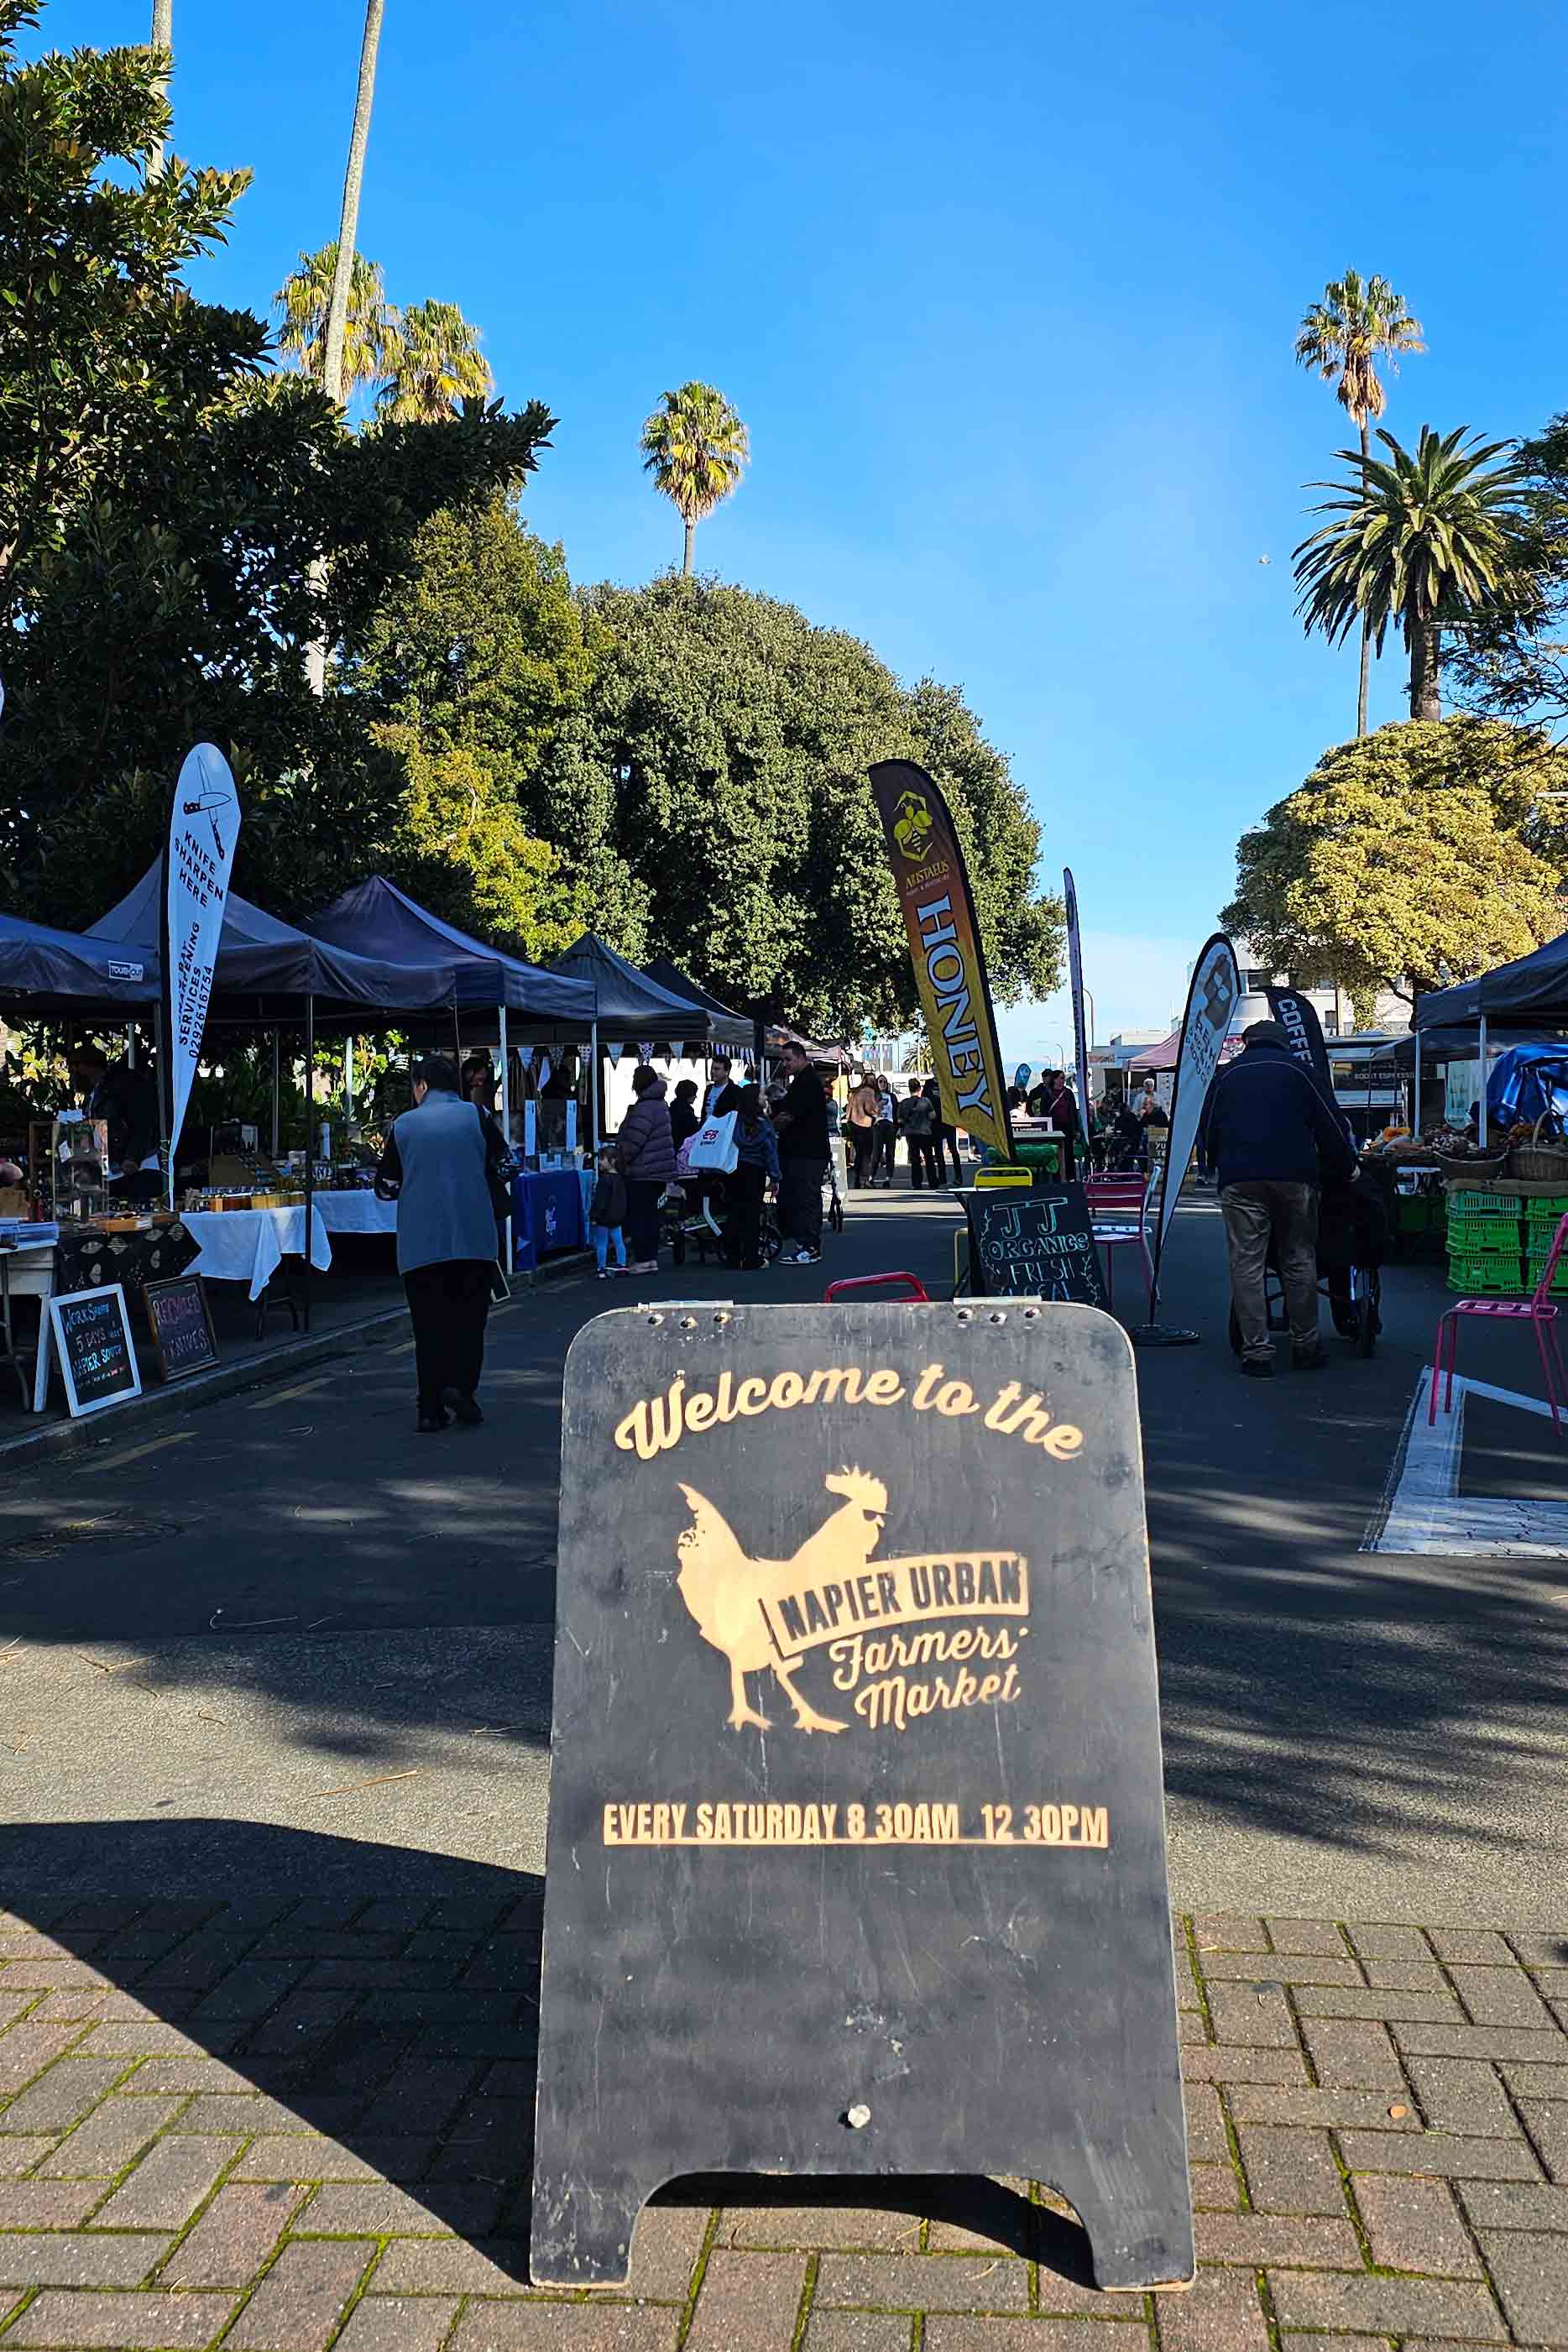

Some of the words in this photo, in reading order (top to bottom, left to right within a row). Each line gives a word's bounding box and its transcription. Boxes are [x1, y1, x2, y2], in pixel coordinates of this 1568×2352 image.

[174, 837, 223, 901] SHARPEN
[184, 829, 216, 875] KNIFE
[179, 867, 208, 907] HERE
[178, 965, 202, 1047] SERVICES
[188, 964, 213, 1059] 0292616754
[916, 892, 996, 1122] HONEY
[1277, 997, 1315, 1068] COFFE
[987, 1231, 1090, 1261] ORGANICS
[1011, 1257, 1075, 1285] FRESH
[614, 1364, 906, 1461] Welcome
[912, 1364, 980, 1417] to
[984, 1381, 1085, 1461] the
[777, 1571, 902, 1642] NAPIER
[908, 1559, 1022, 1610] URBAN
[853, 1663, 1022, 1732] Market
[604, 1804, 687, 1842] EVERY
[696, 1804, 839, 1842] SATURDAY
